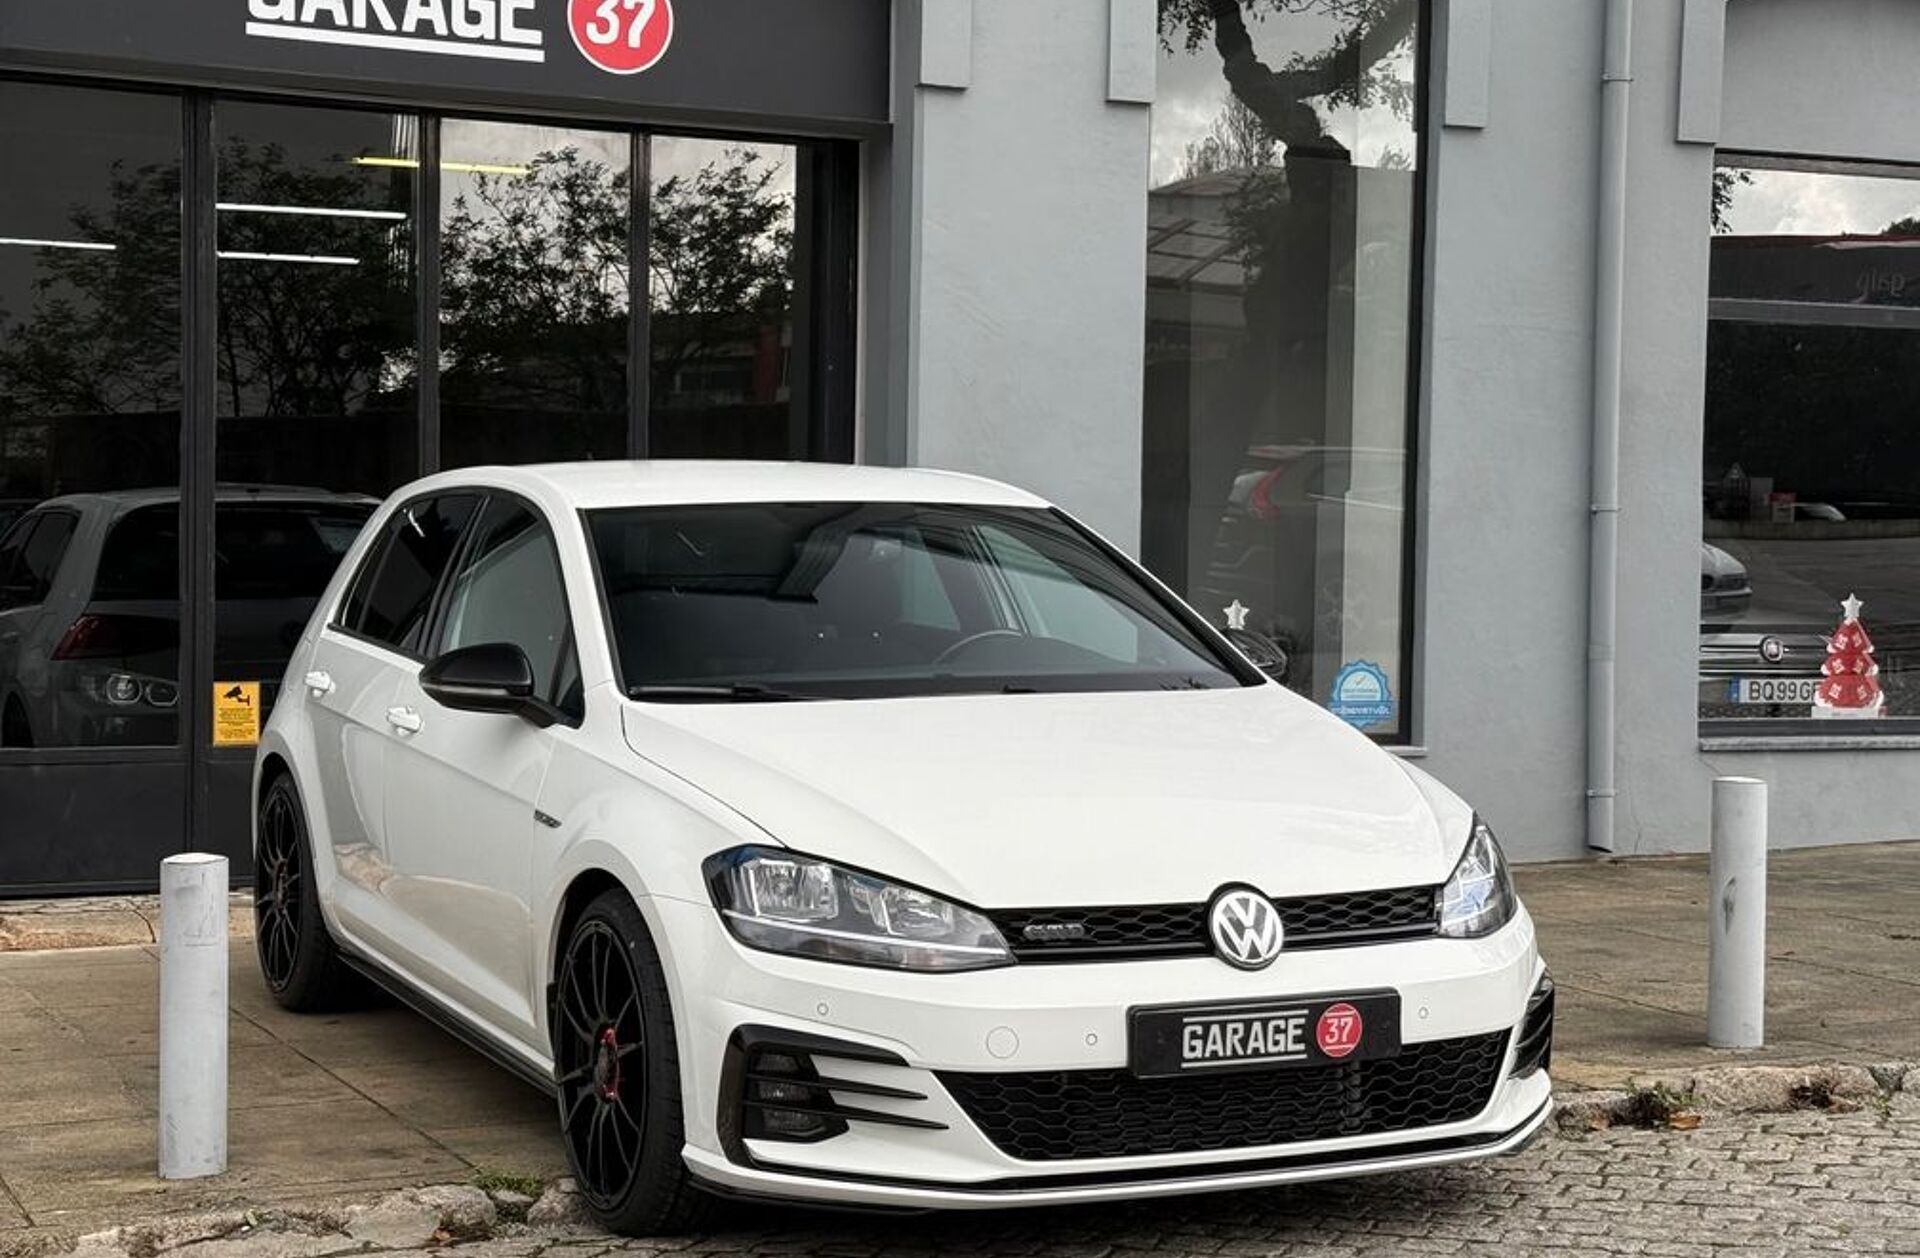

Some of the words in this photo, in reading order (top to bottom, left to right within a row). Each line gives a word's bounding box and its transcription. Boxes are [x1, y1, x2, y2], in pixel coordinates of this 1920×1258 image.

[586, 0, 656, 48] 37
[1183, 1018, 1306, 1059] GARAGE
[1325, 1017, 1353, 1044] 37
